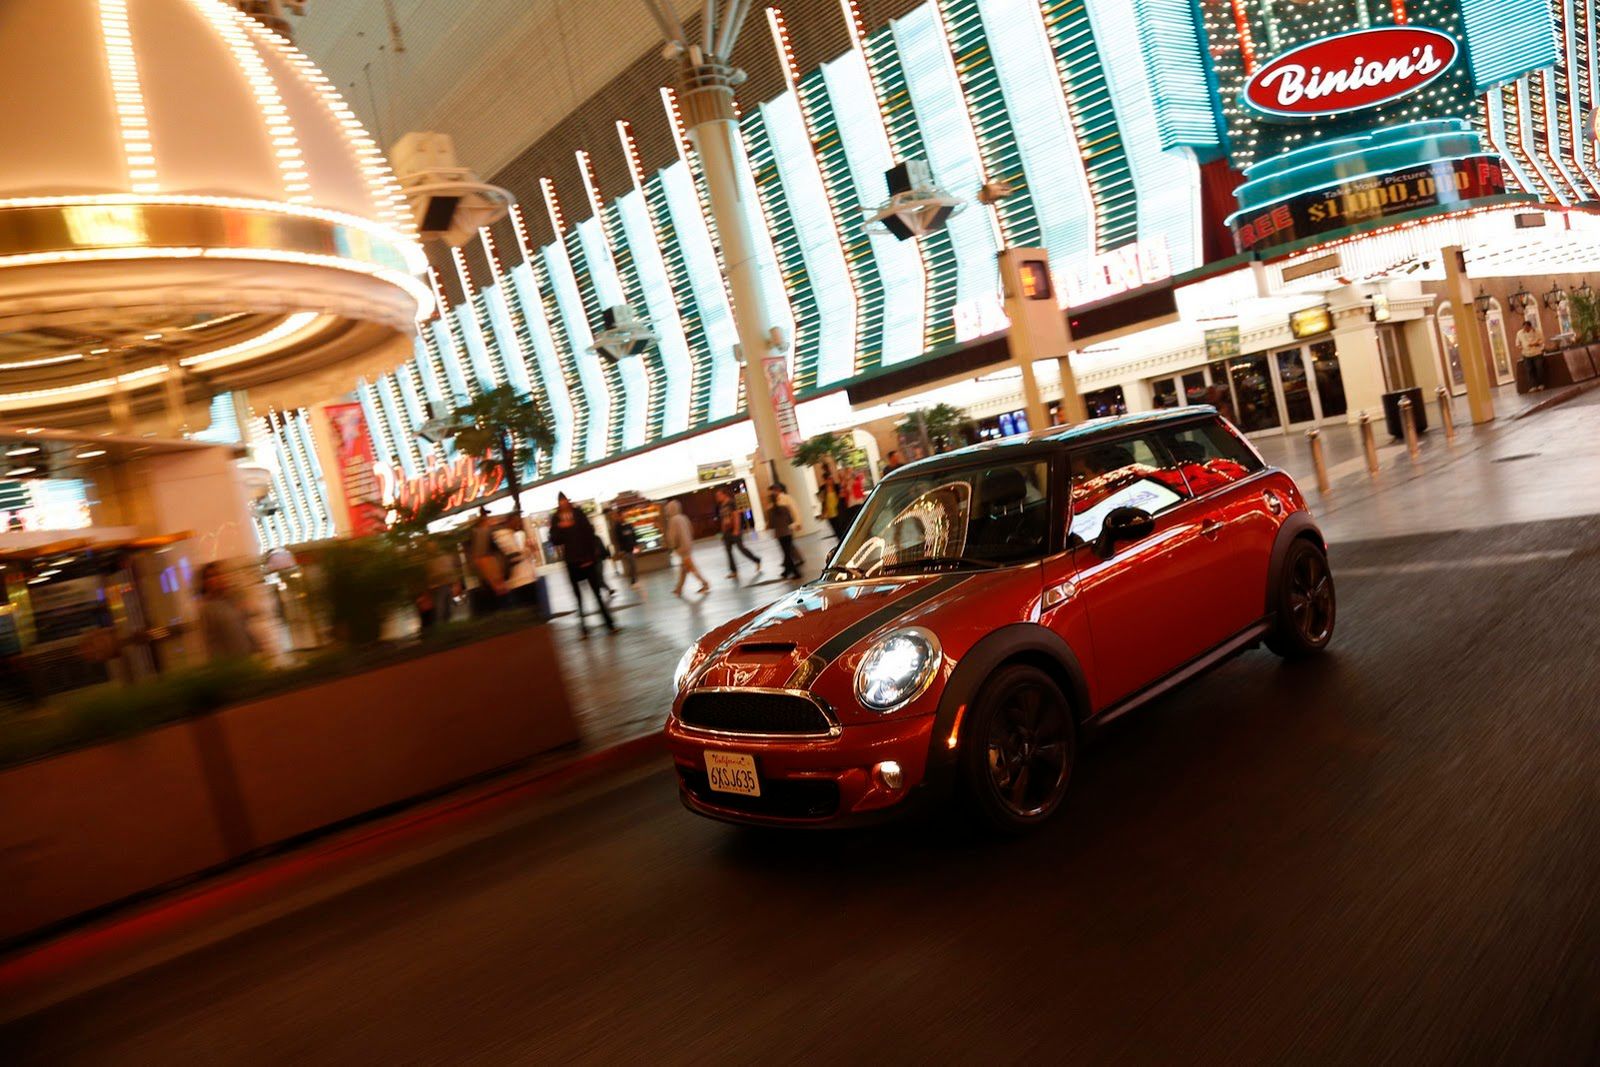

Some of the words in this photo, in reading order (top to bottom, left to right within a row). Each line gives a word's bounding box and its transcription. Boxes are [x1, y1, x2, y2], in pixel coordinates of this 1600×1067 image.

[1260, 44, 1442, 105] Binion's
[1323, 185, 1352, 200] Take
[1353, 179, 1382, 194] Your
[1384, 170, 1427, 185] Picture
[1240, 204, 1294, 248] REE
[714, 754, 743, 767] California
[711, 767, 755, 790] 6XSJ635
